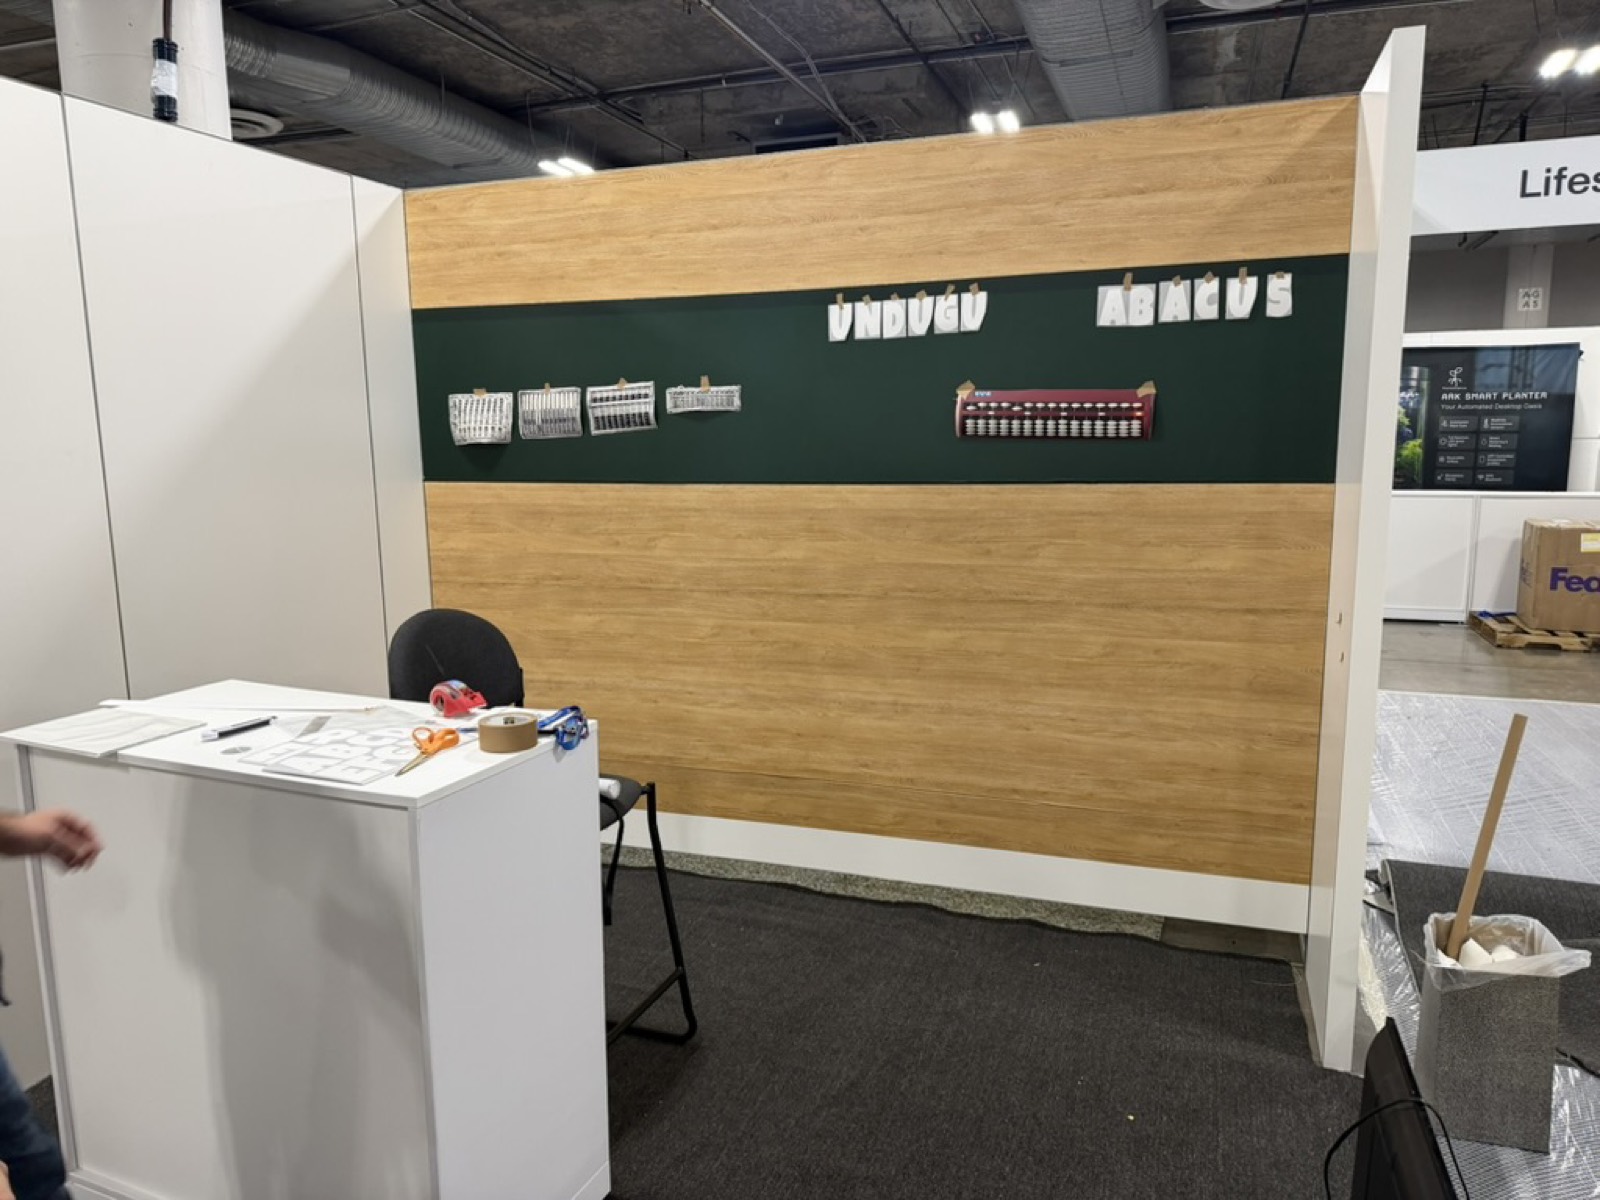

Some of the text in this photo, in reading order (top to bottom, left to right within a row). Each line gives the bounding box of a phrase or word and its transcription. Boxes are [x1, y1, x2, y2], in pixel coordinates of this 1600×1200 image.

[829, 292, 987, 341] UNDUGU
[1098, 274, 1292, 326] ABACUS
[1441, 391, 1548, 401] ARK SMART PLANTER
